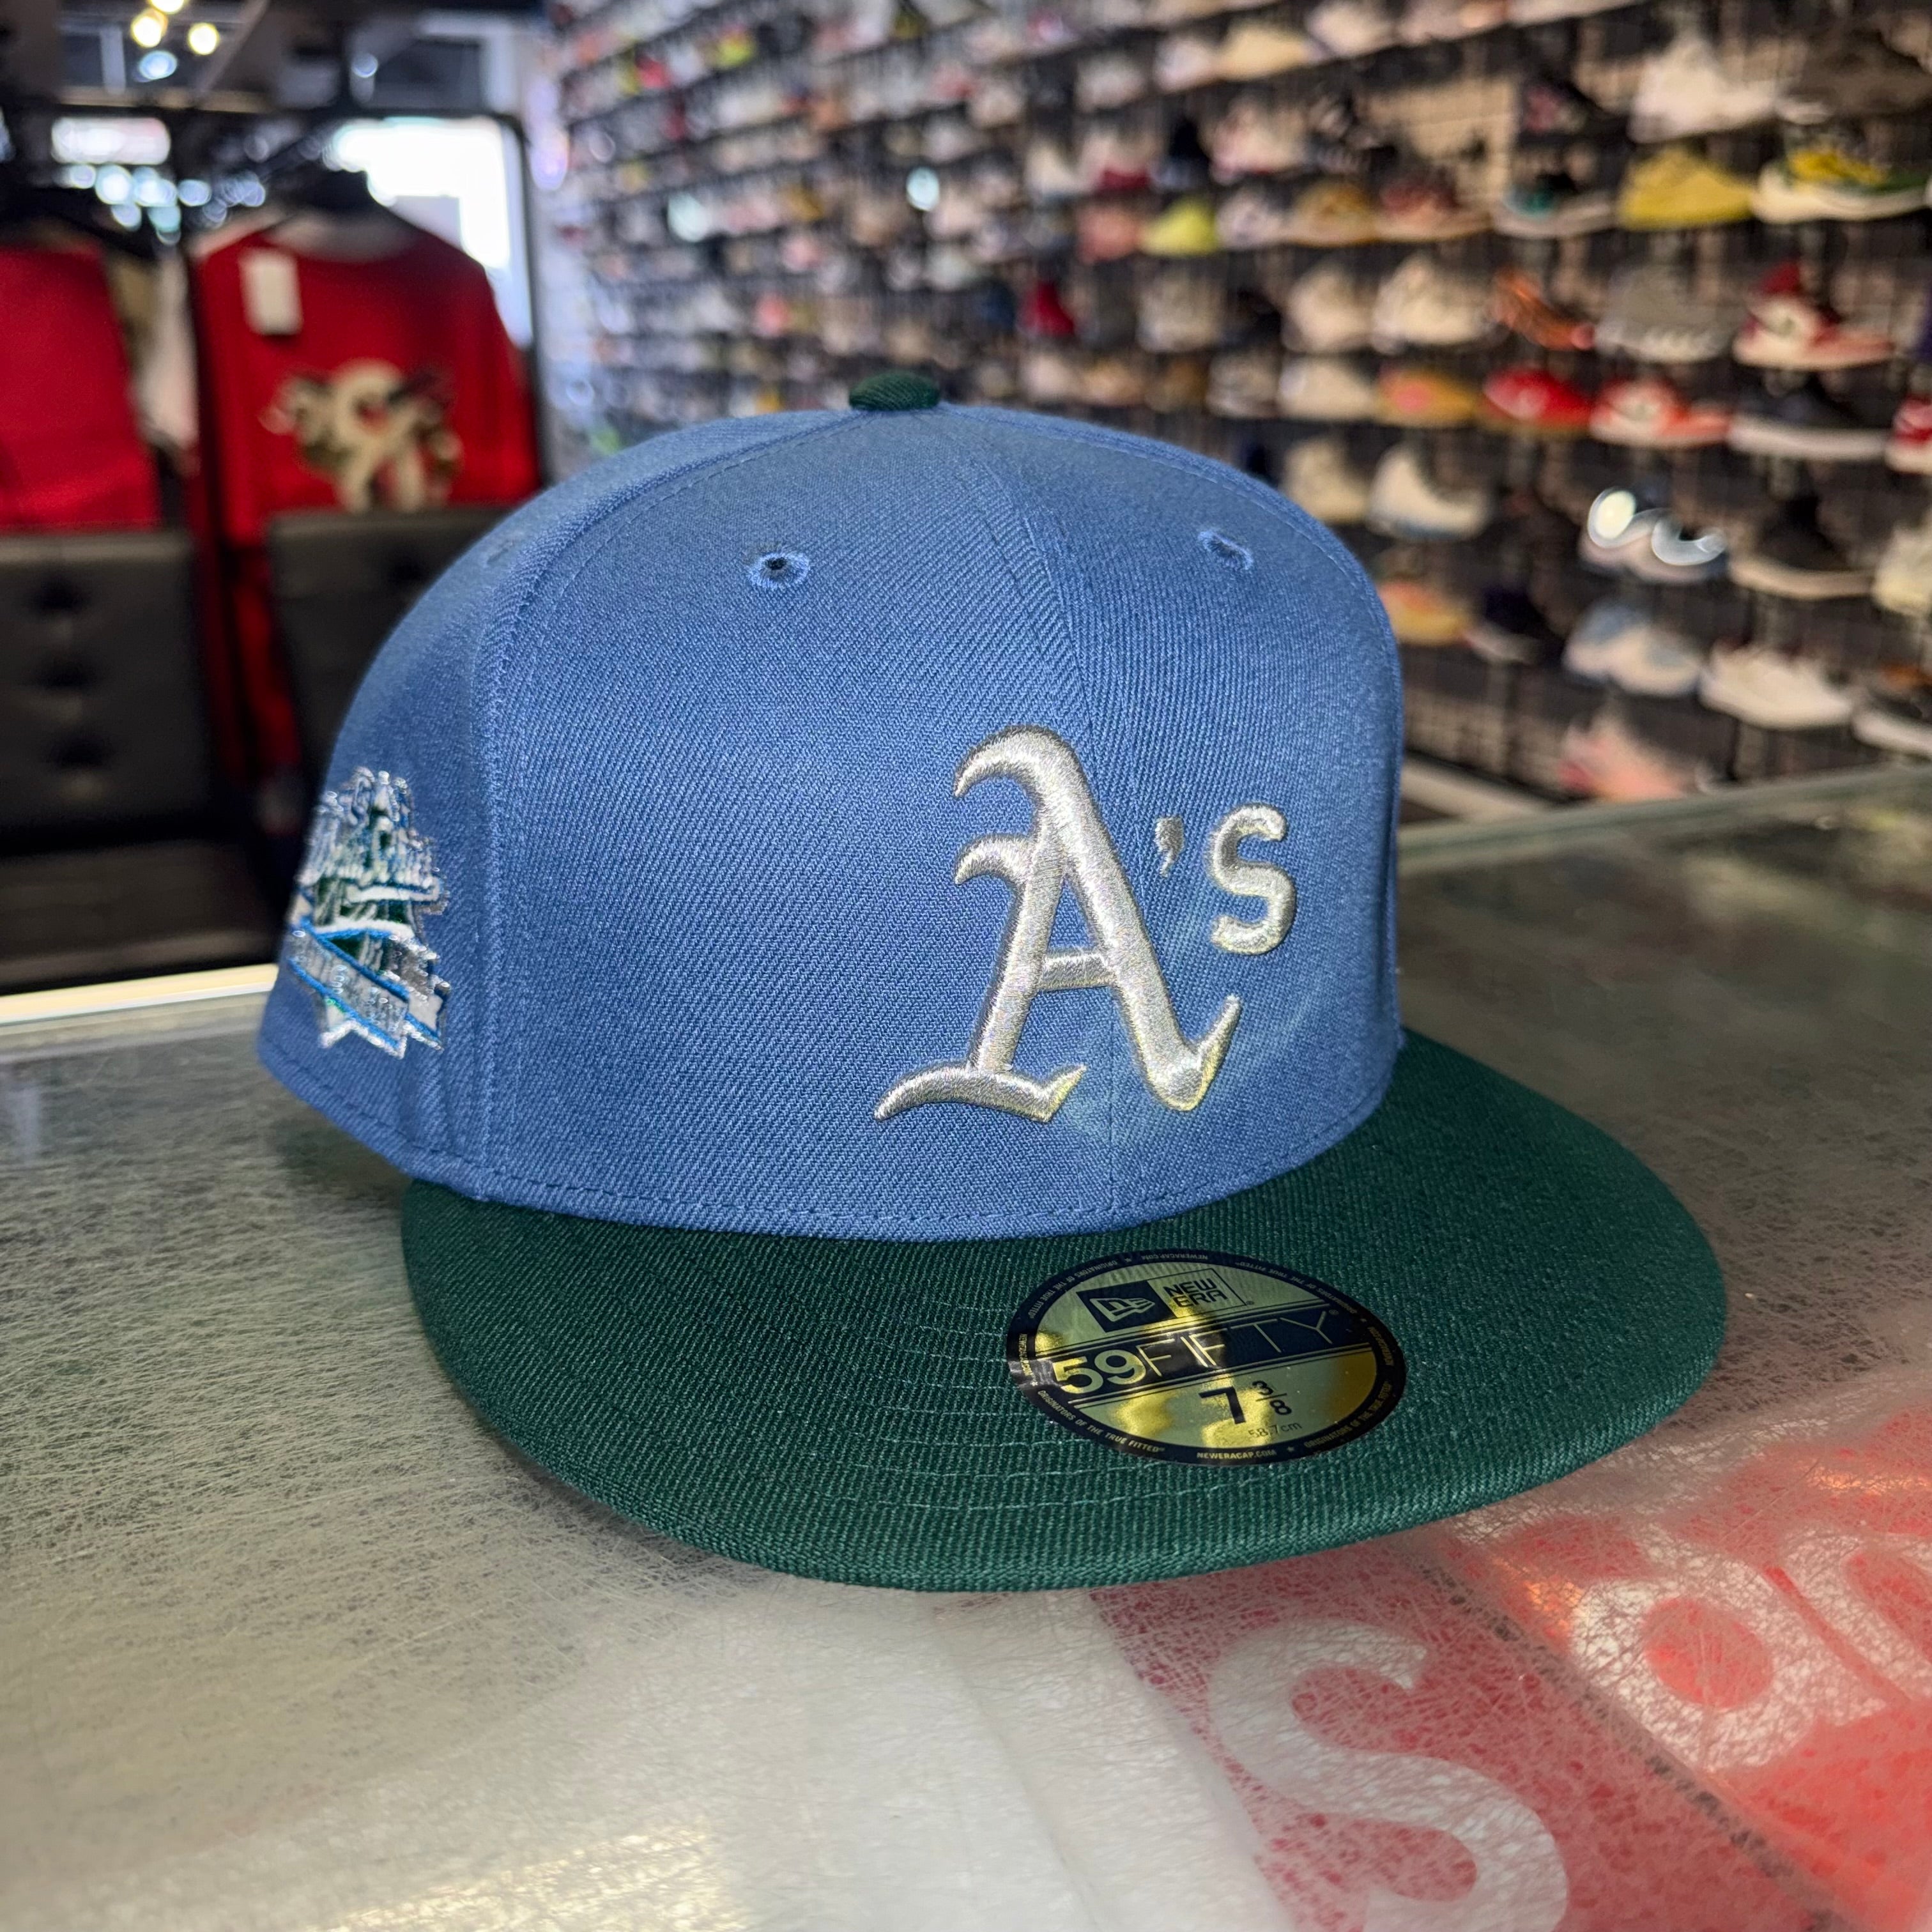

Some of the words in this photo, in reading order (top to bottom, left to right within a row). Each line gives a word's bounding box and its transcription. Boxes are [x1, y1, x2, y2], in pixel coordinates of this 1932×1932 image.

[873, 724, 1297, 1123] A's
[1163, 1278, 1217, 1298] NEW
[1174, 1290, 1228, 1308] ERA
[1037, 1390, 1077, 1420] ORIGINATORS
[1087, 1425, 1103, 1435] THE
[1105, 1432, 1128, 1445] TRUE
[1199, 1385, 1246, 1424] 7
[1197, 1449, 1276, 1460] NEWERACAP.COM
